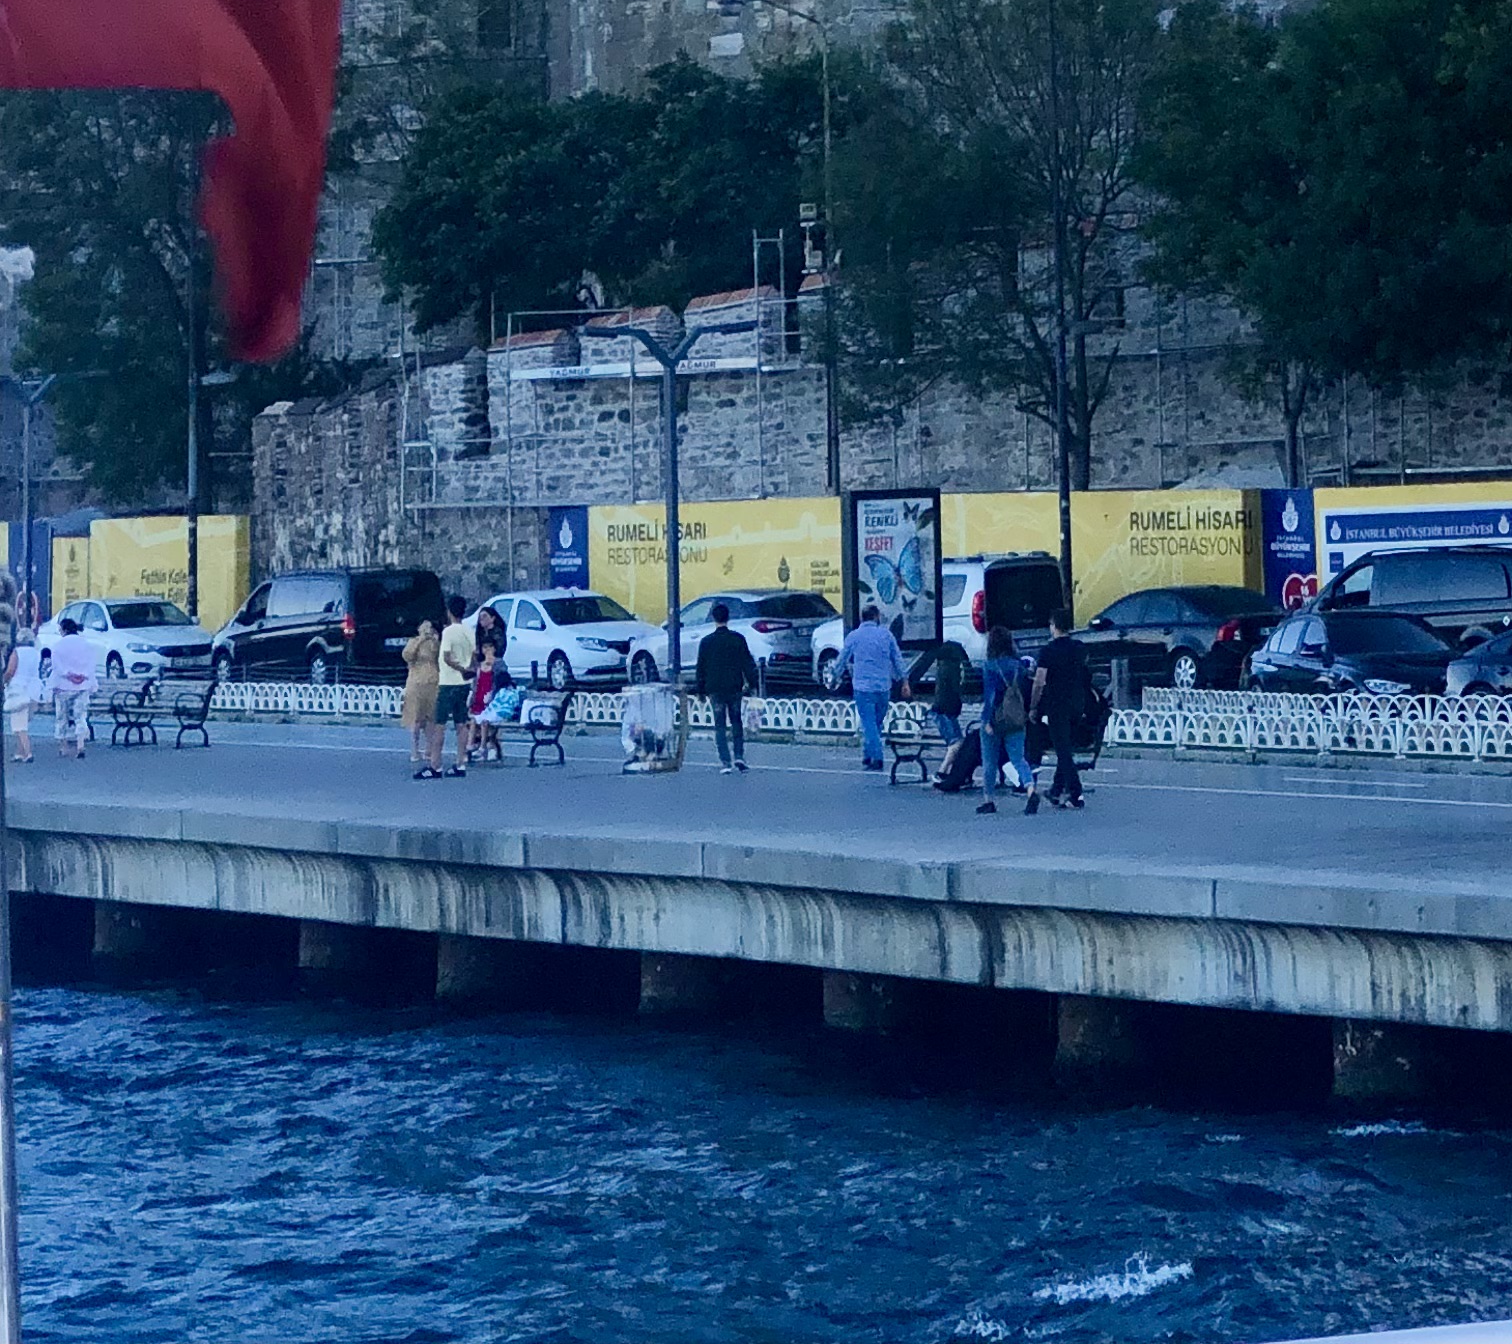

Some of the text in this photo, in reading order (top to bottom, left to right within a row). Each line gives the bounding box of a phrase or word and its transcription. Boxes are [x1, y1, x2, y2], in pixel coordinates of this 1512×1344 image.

[1130, 506, 1252, 531] RUMELİ HİSARI
[607, 518, 706, 542] RUMELİ HSARI
[1345, 526, 1387, 541] İSTANBUL
[607, 546, 708, 566] RESTORAONU
[1130, 536, 1253, 556] RESTORASYONU
